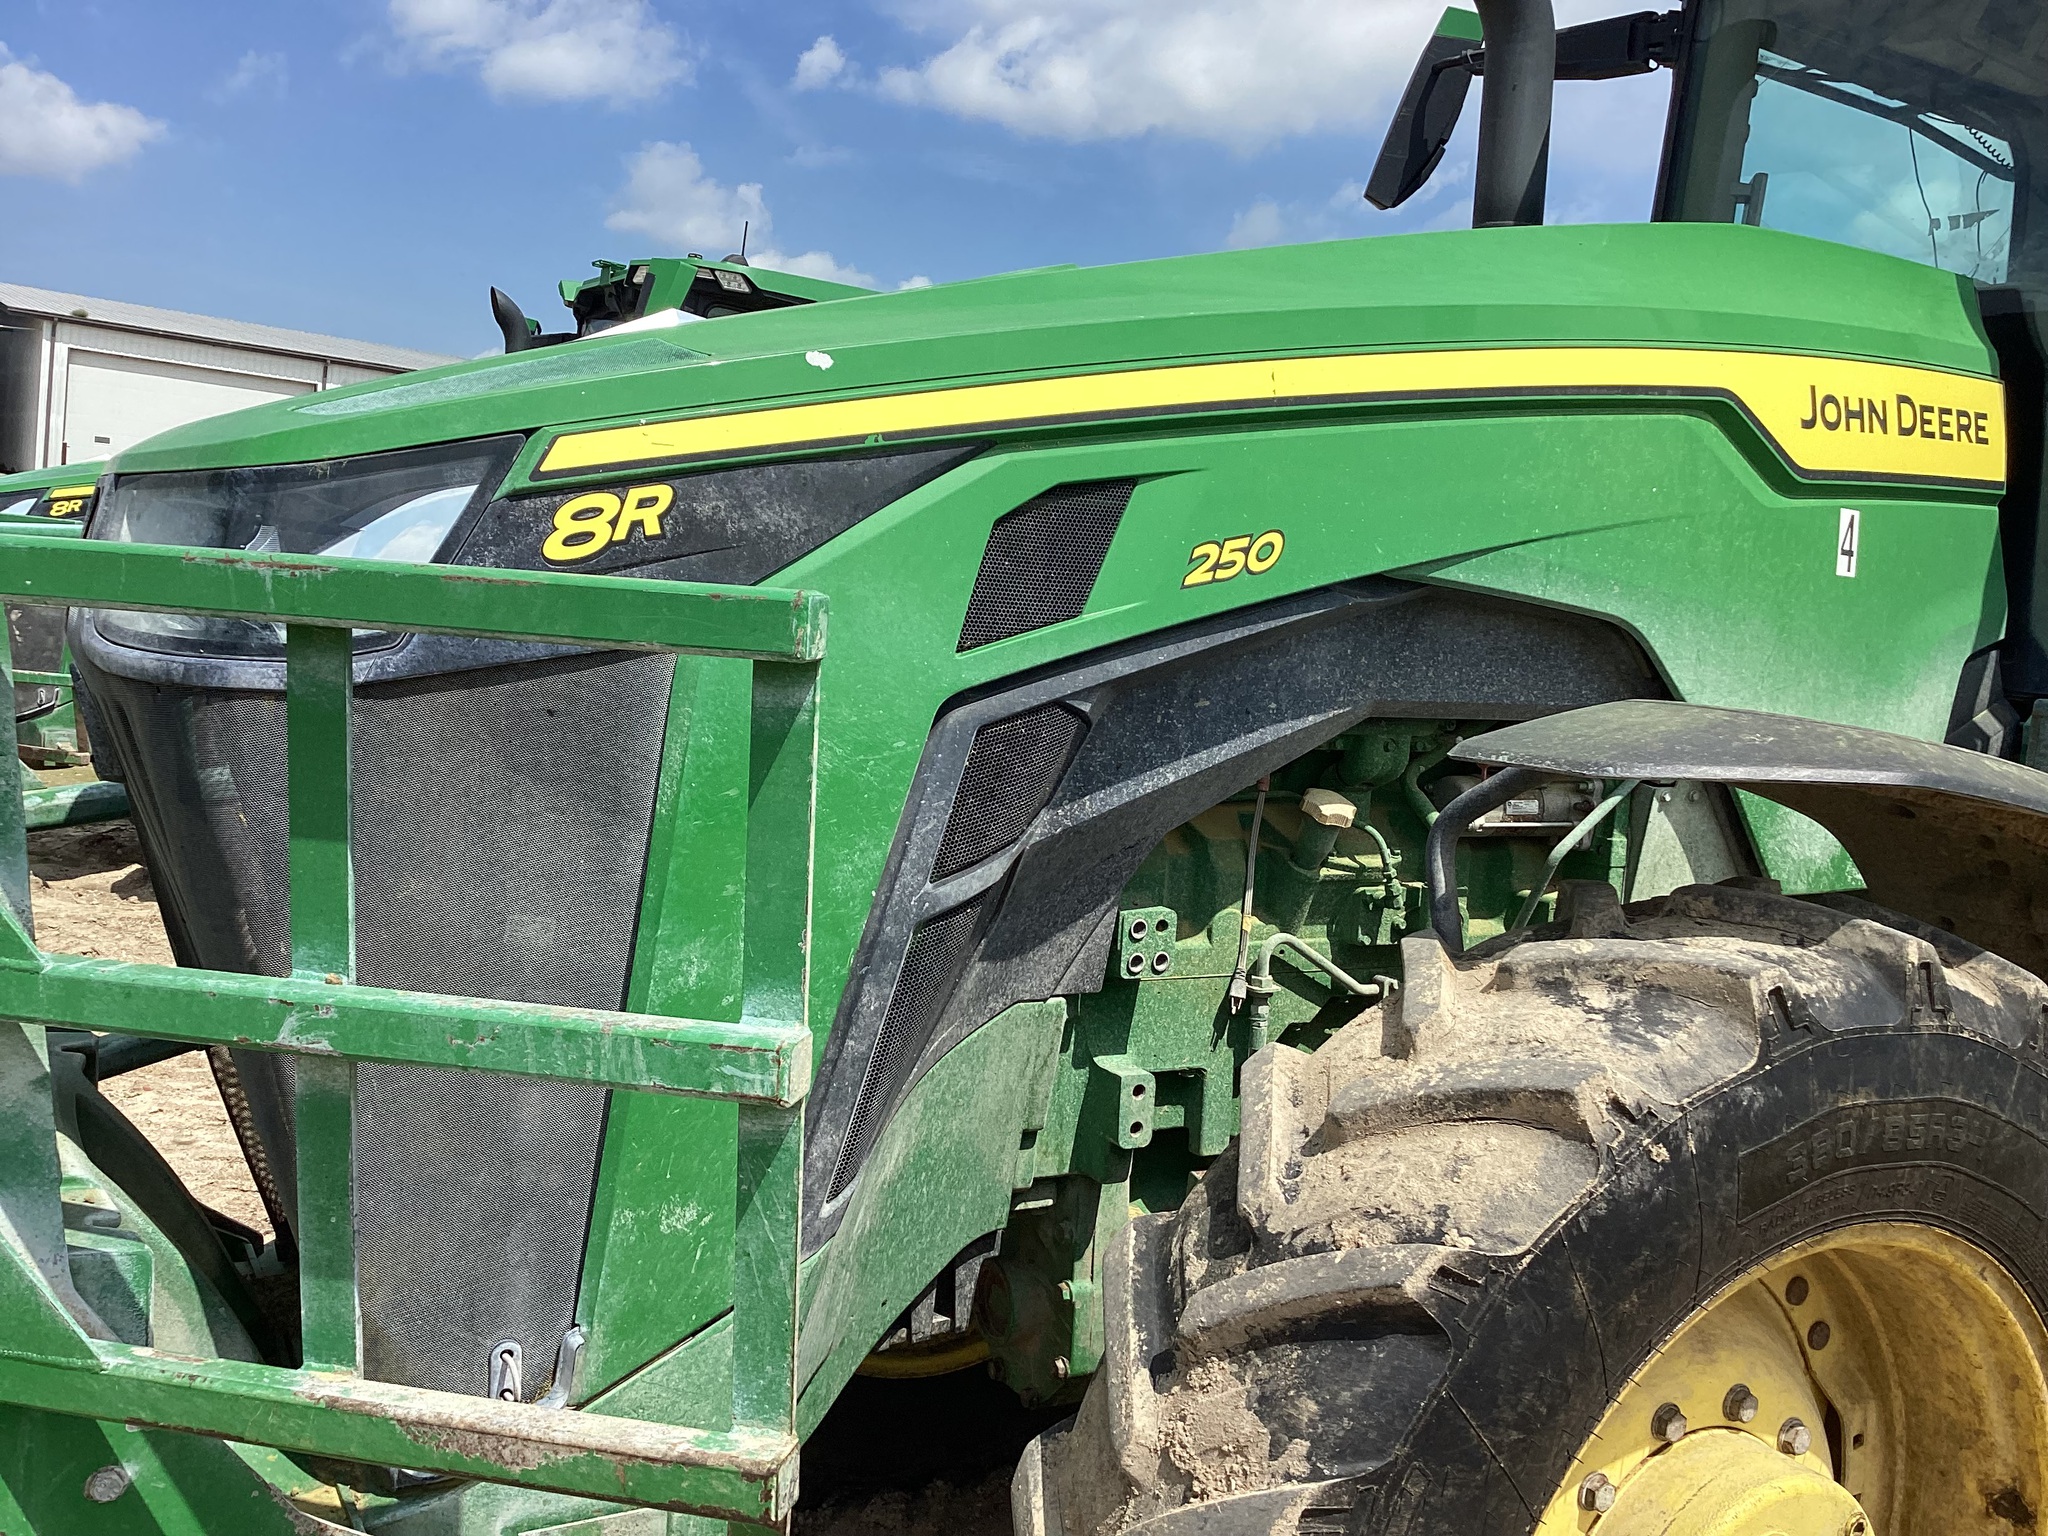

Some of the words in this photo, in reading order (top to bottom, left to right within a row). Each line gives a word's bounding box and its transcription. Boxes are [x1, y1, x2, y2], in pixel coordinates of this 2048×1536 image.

[49, 499, 83, 517] 8R
[540, 482, 677, 568] 8R
[1180, 529, 1285, 590] 250
[1840, 514, 1855, 572] 4
